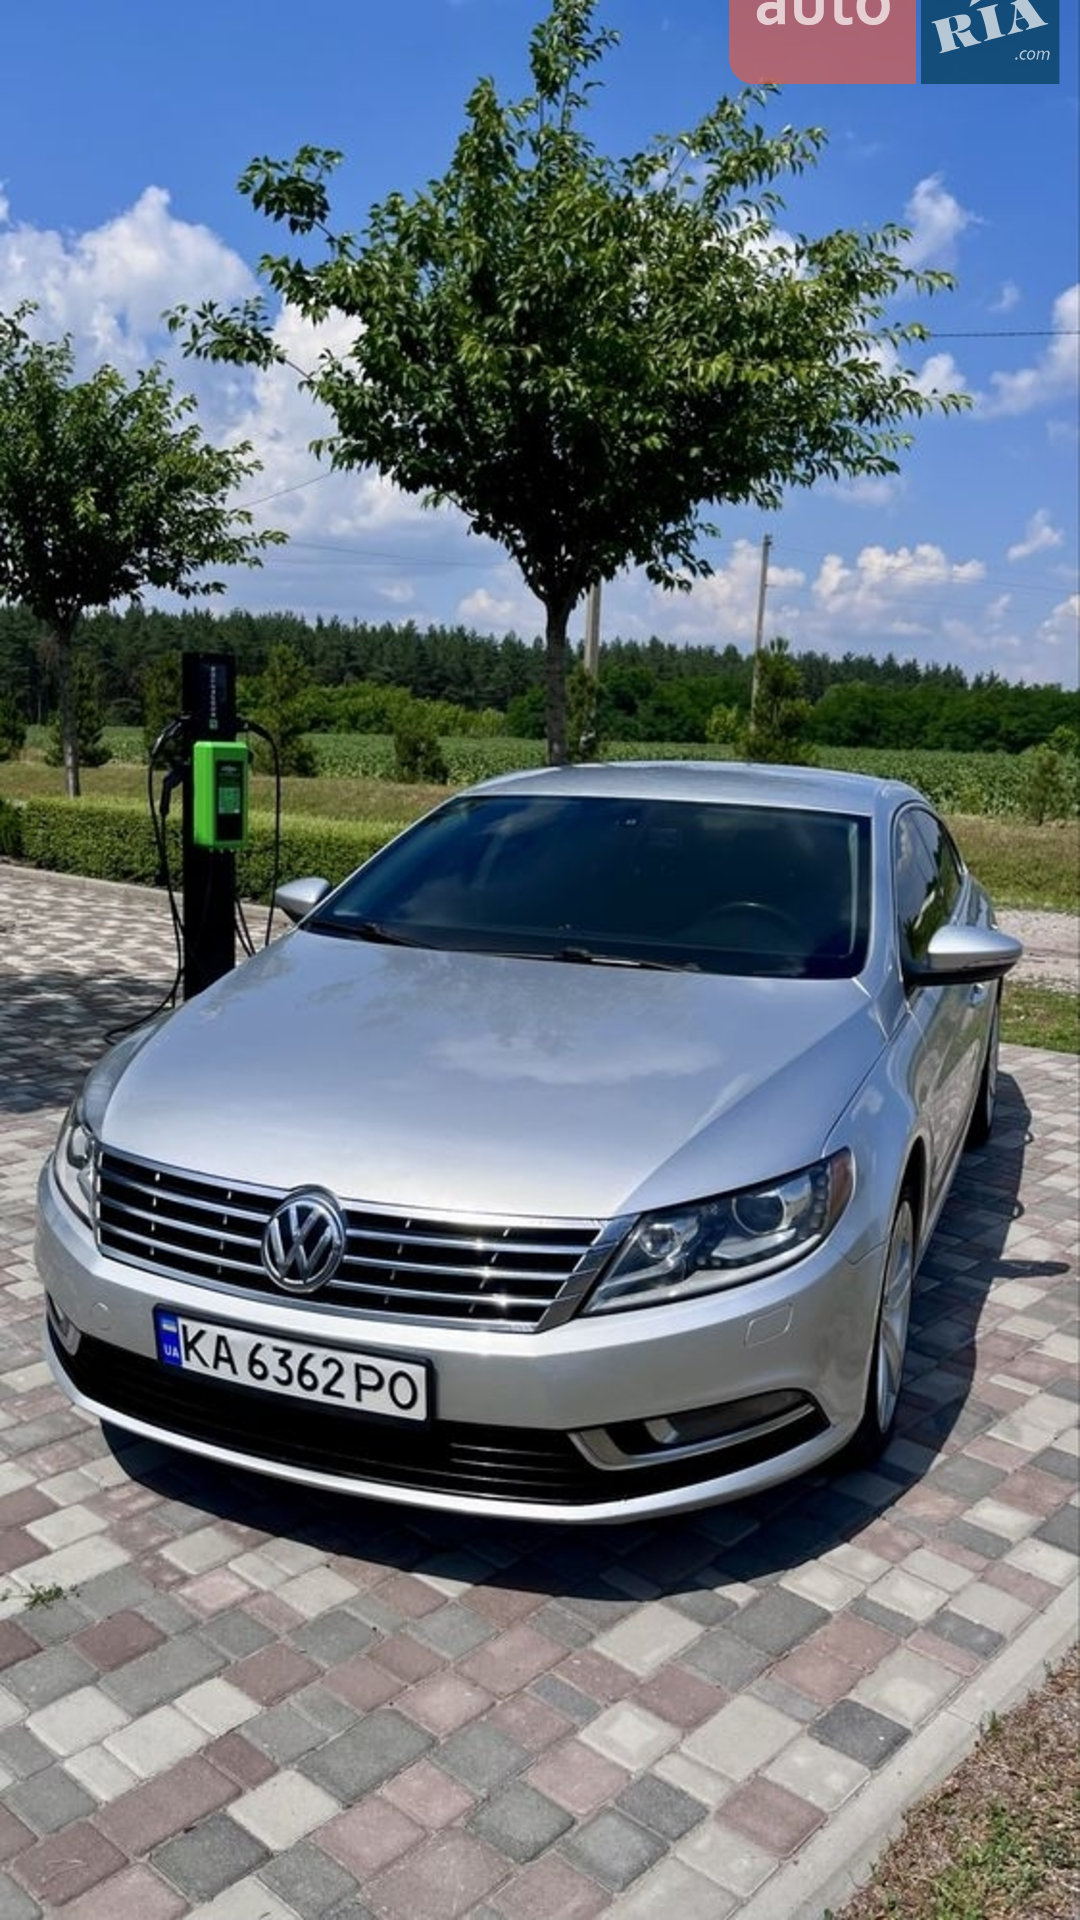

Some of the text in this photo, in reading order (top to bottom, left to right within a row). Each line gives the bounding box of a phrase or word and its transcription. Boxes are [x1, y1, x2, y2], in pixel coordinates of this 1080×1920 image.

[164, 1344, 179, 1358] UA
[182, 1324, 419, 1411] KA 6362 PO
